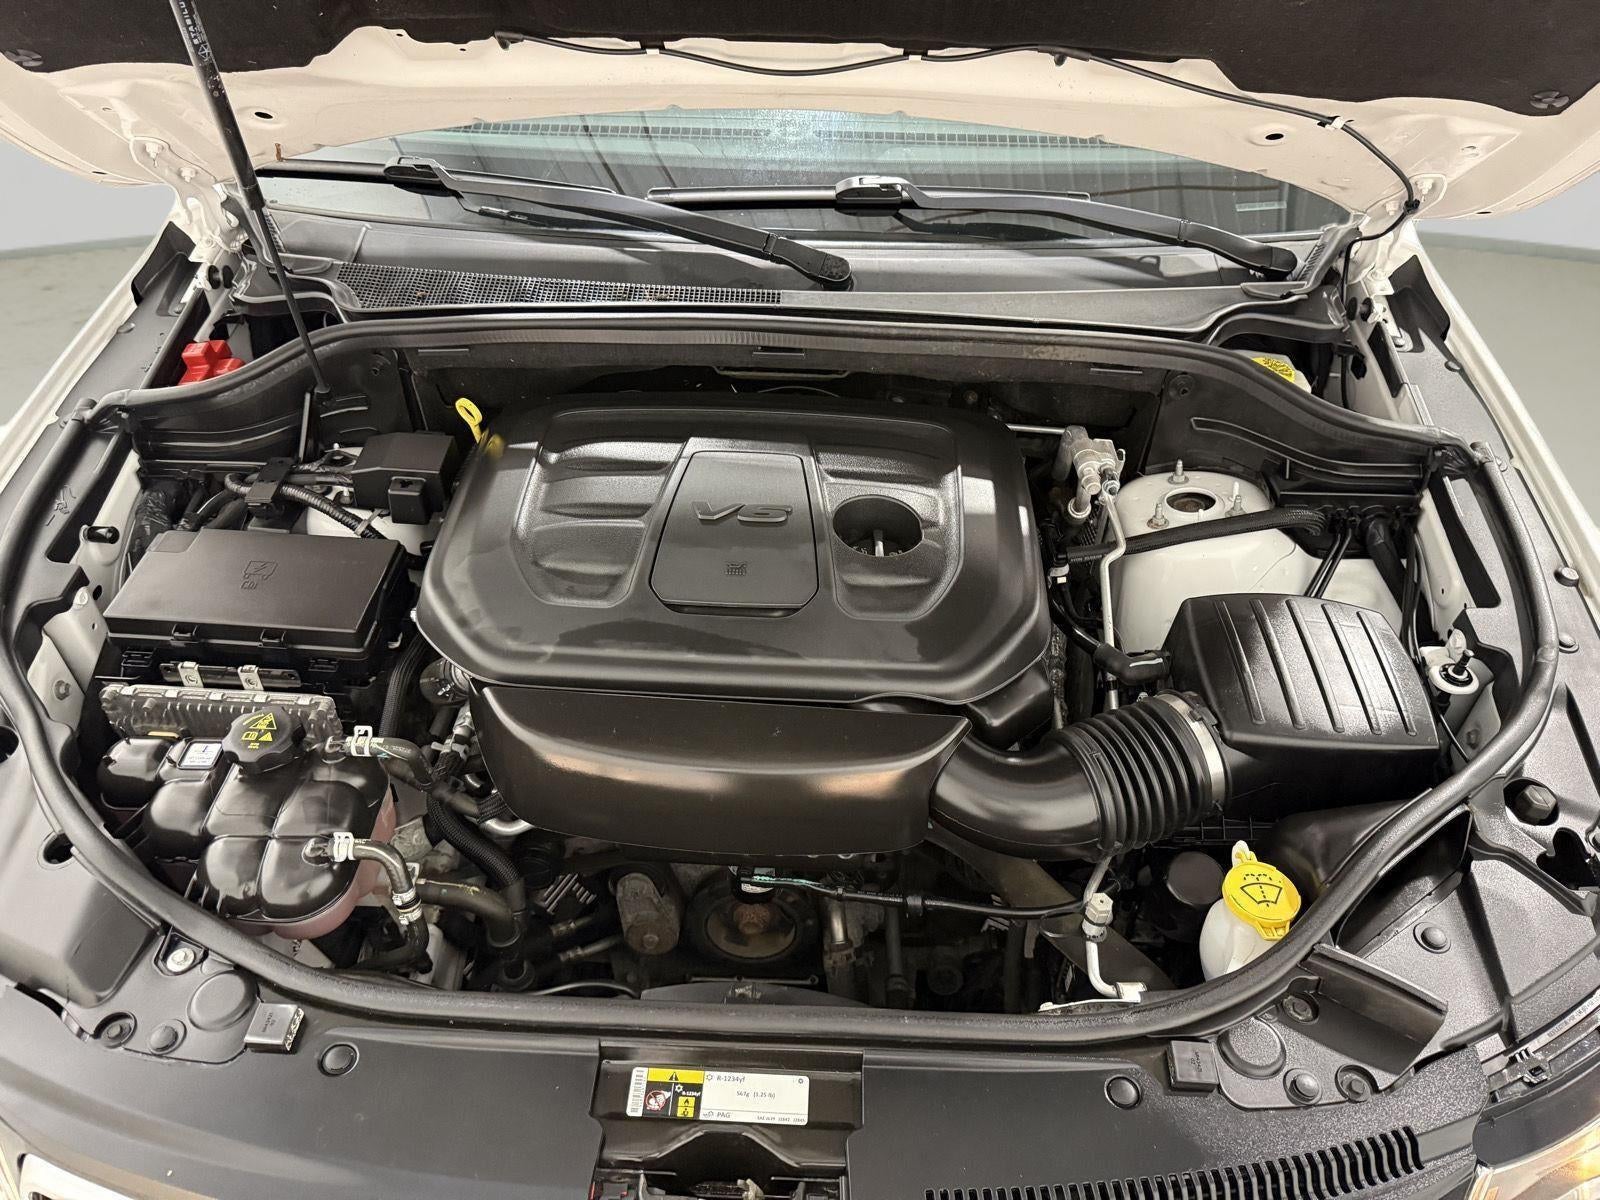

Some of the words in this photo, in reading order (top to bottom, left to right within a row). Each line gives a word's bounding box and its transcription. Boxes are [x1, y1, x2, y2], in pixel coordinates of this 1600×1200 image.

[178, 0, 200, 45] STABILU
[691, 500, 793, 525] V6
[716, 1075, 745, 1083] R-1234yf
